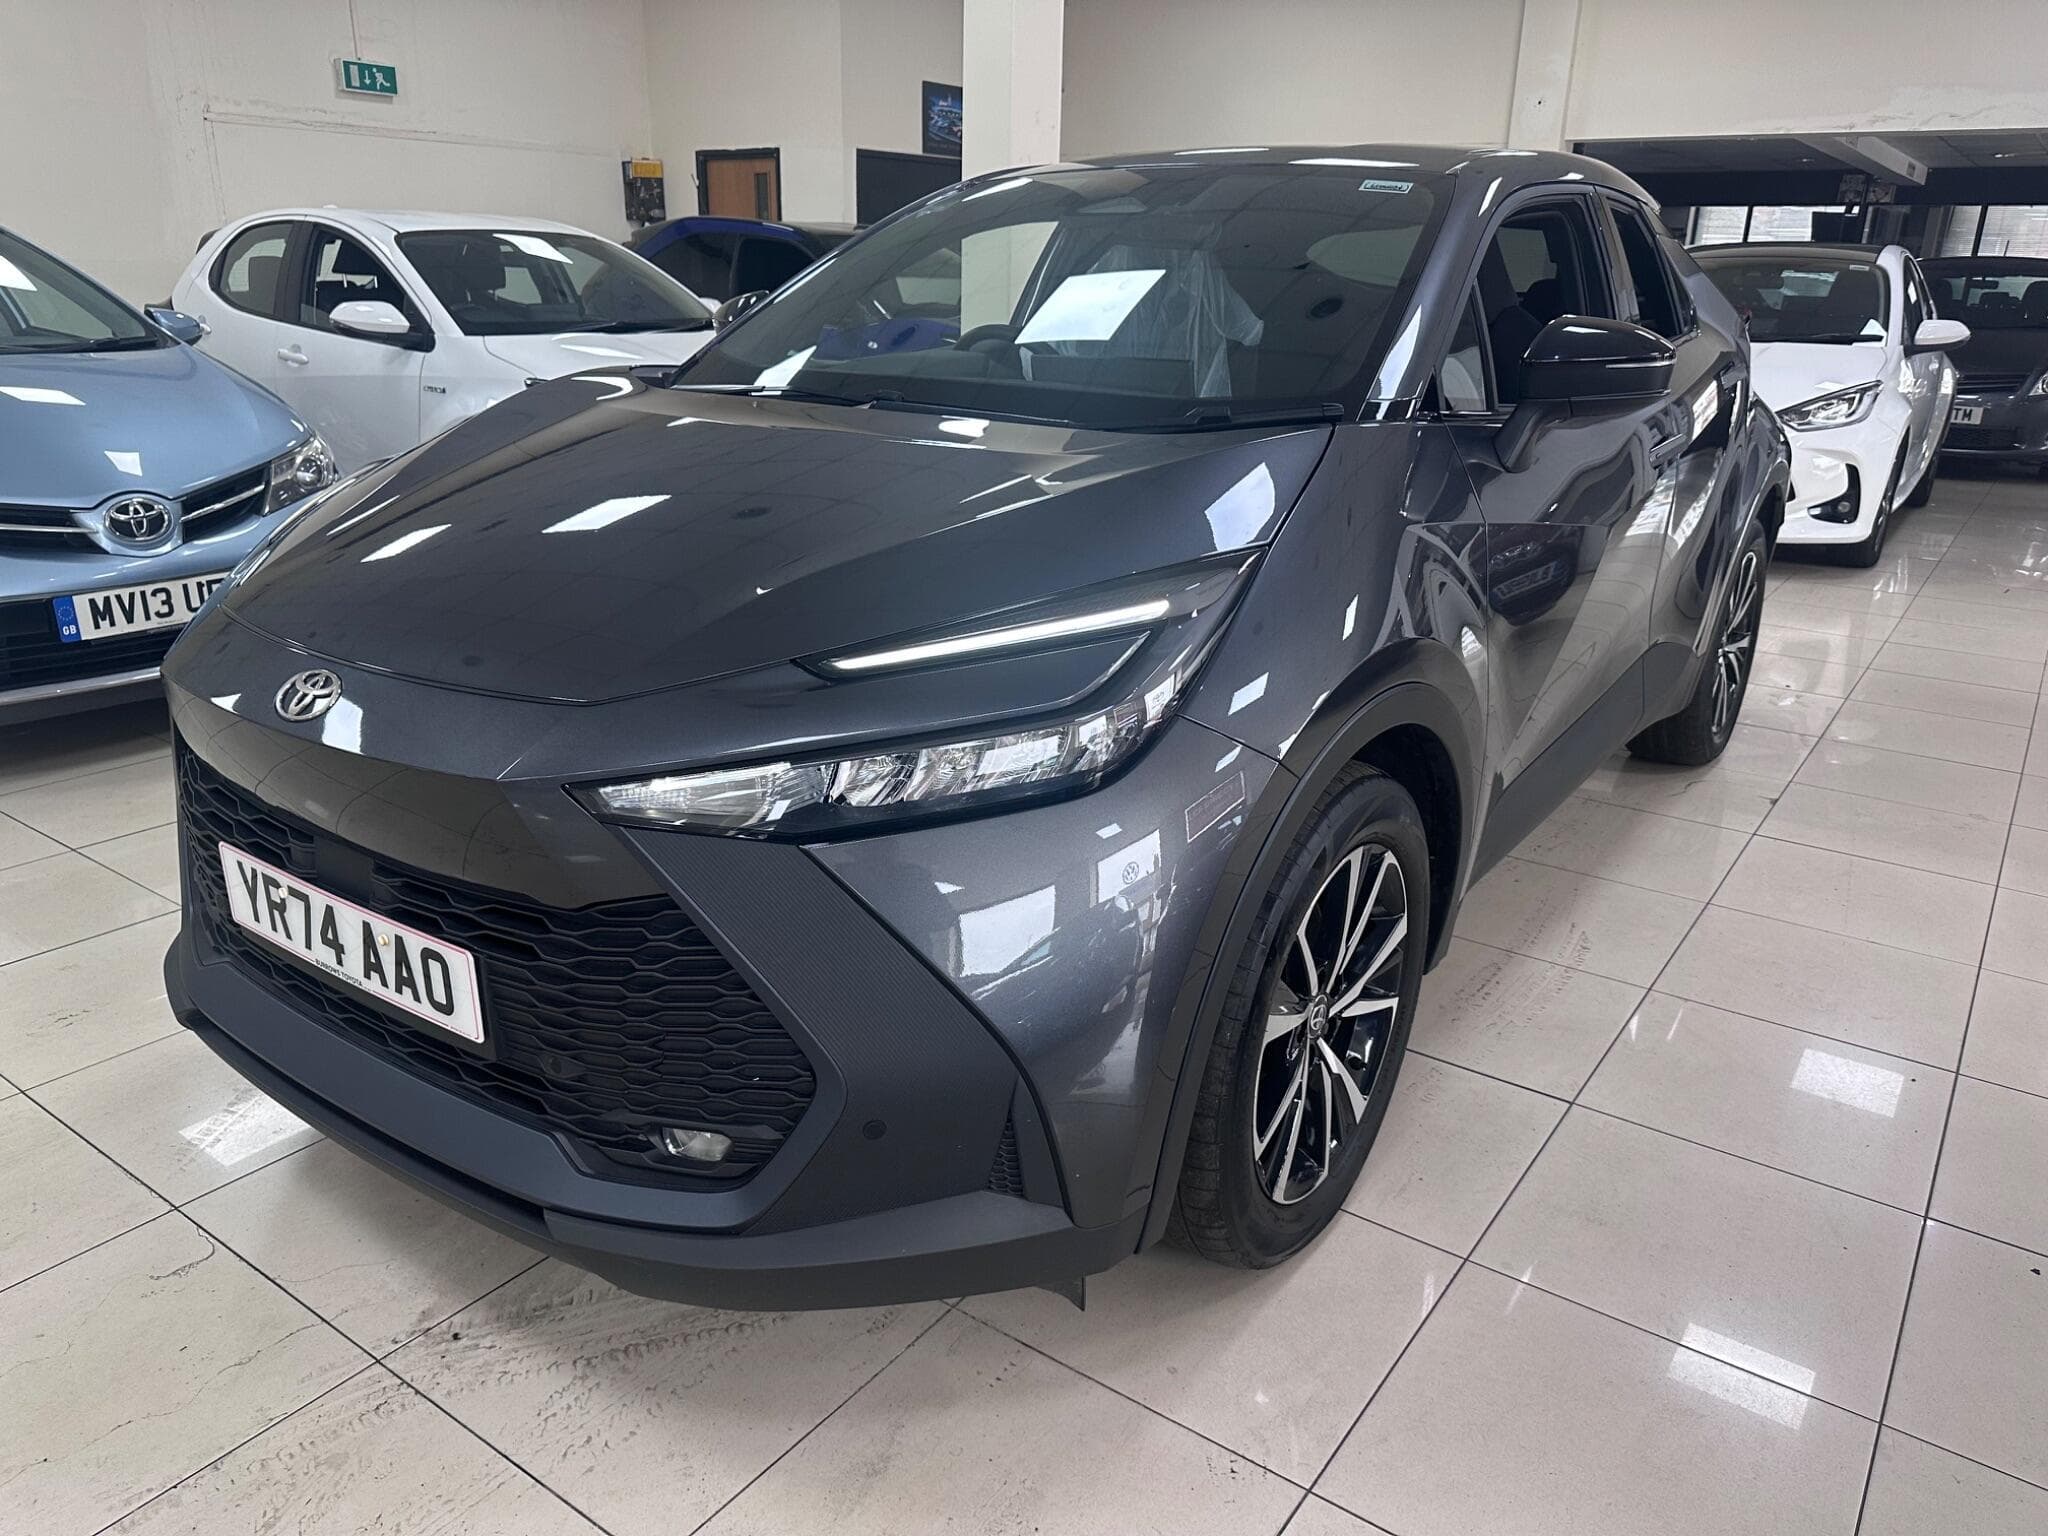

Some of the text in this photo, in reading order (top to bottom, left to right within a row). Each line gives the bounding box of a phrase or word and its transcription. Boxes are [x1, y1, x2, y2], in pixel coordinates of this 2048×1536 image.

[88, 587, 175, 630] MV13
[62, 624, 77, 635] GB
[236, 860, 346, 967] YR74
[340, 972, 363, 986] TOYOTA
